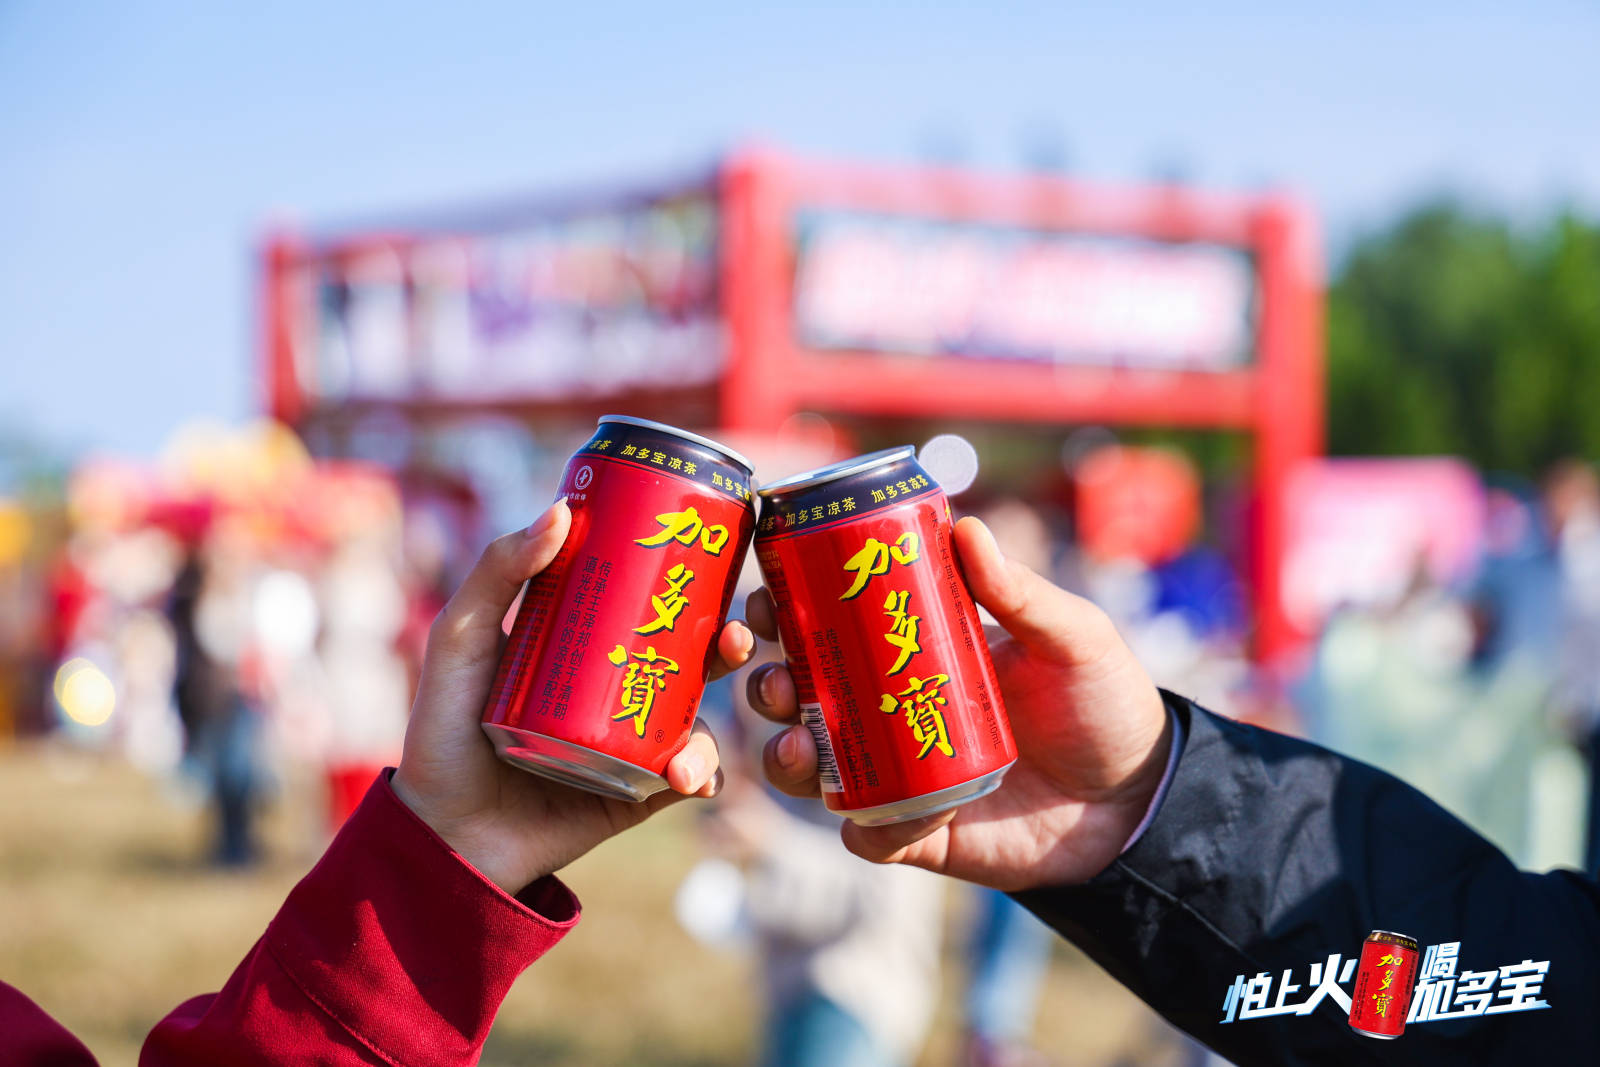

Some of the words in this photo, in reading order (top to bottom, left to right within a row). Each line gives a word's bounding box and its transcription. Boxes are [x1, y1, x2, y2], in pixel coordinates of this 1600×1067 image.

[620, 443, 697, 477] 加多宝凉茶
[870, 474, 930, 504] 加多宝凉茶
[784, 496, 857, 529] 加多宝凉茶
[607, 506, 730, 739] 加多寶
[839, 531, 956, 761] 加多寶
